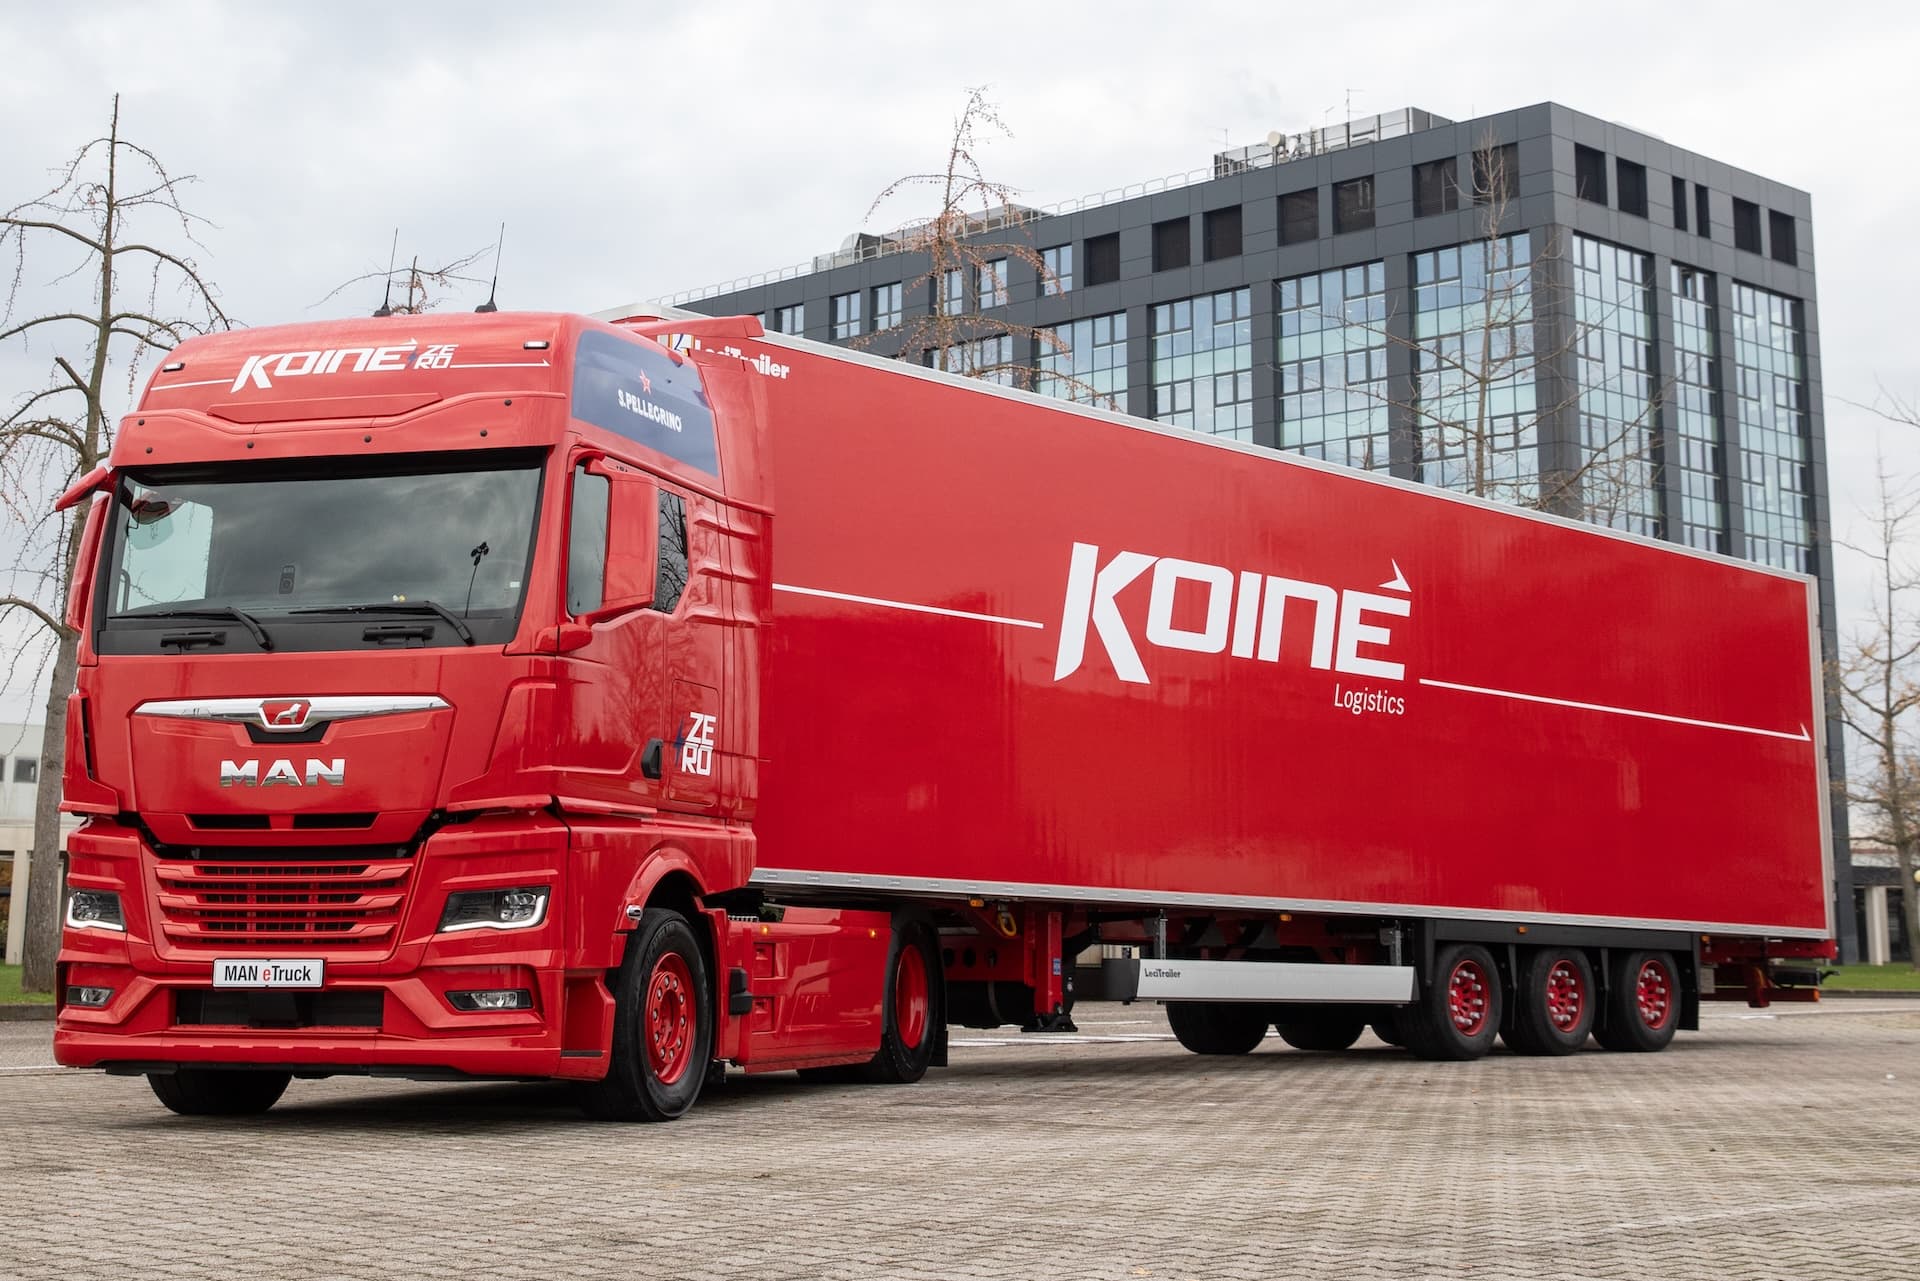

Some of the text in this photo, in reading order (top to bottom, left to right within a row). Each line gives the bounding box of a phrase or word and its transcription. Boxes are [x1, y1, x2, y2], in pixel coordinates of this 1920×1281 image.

[1334, 683, 1405, 715] Logistics
[220, 758, 346, 787] MAN
[224, 965, 312, 982] MAN eTruck
